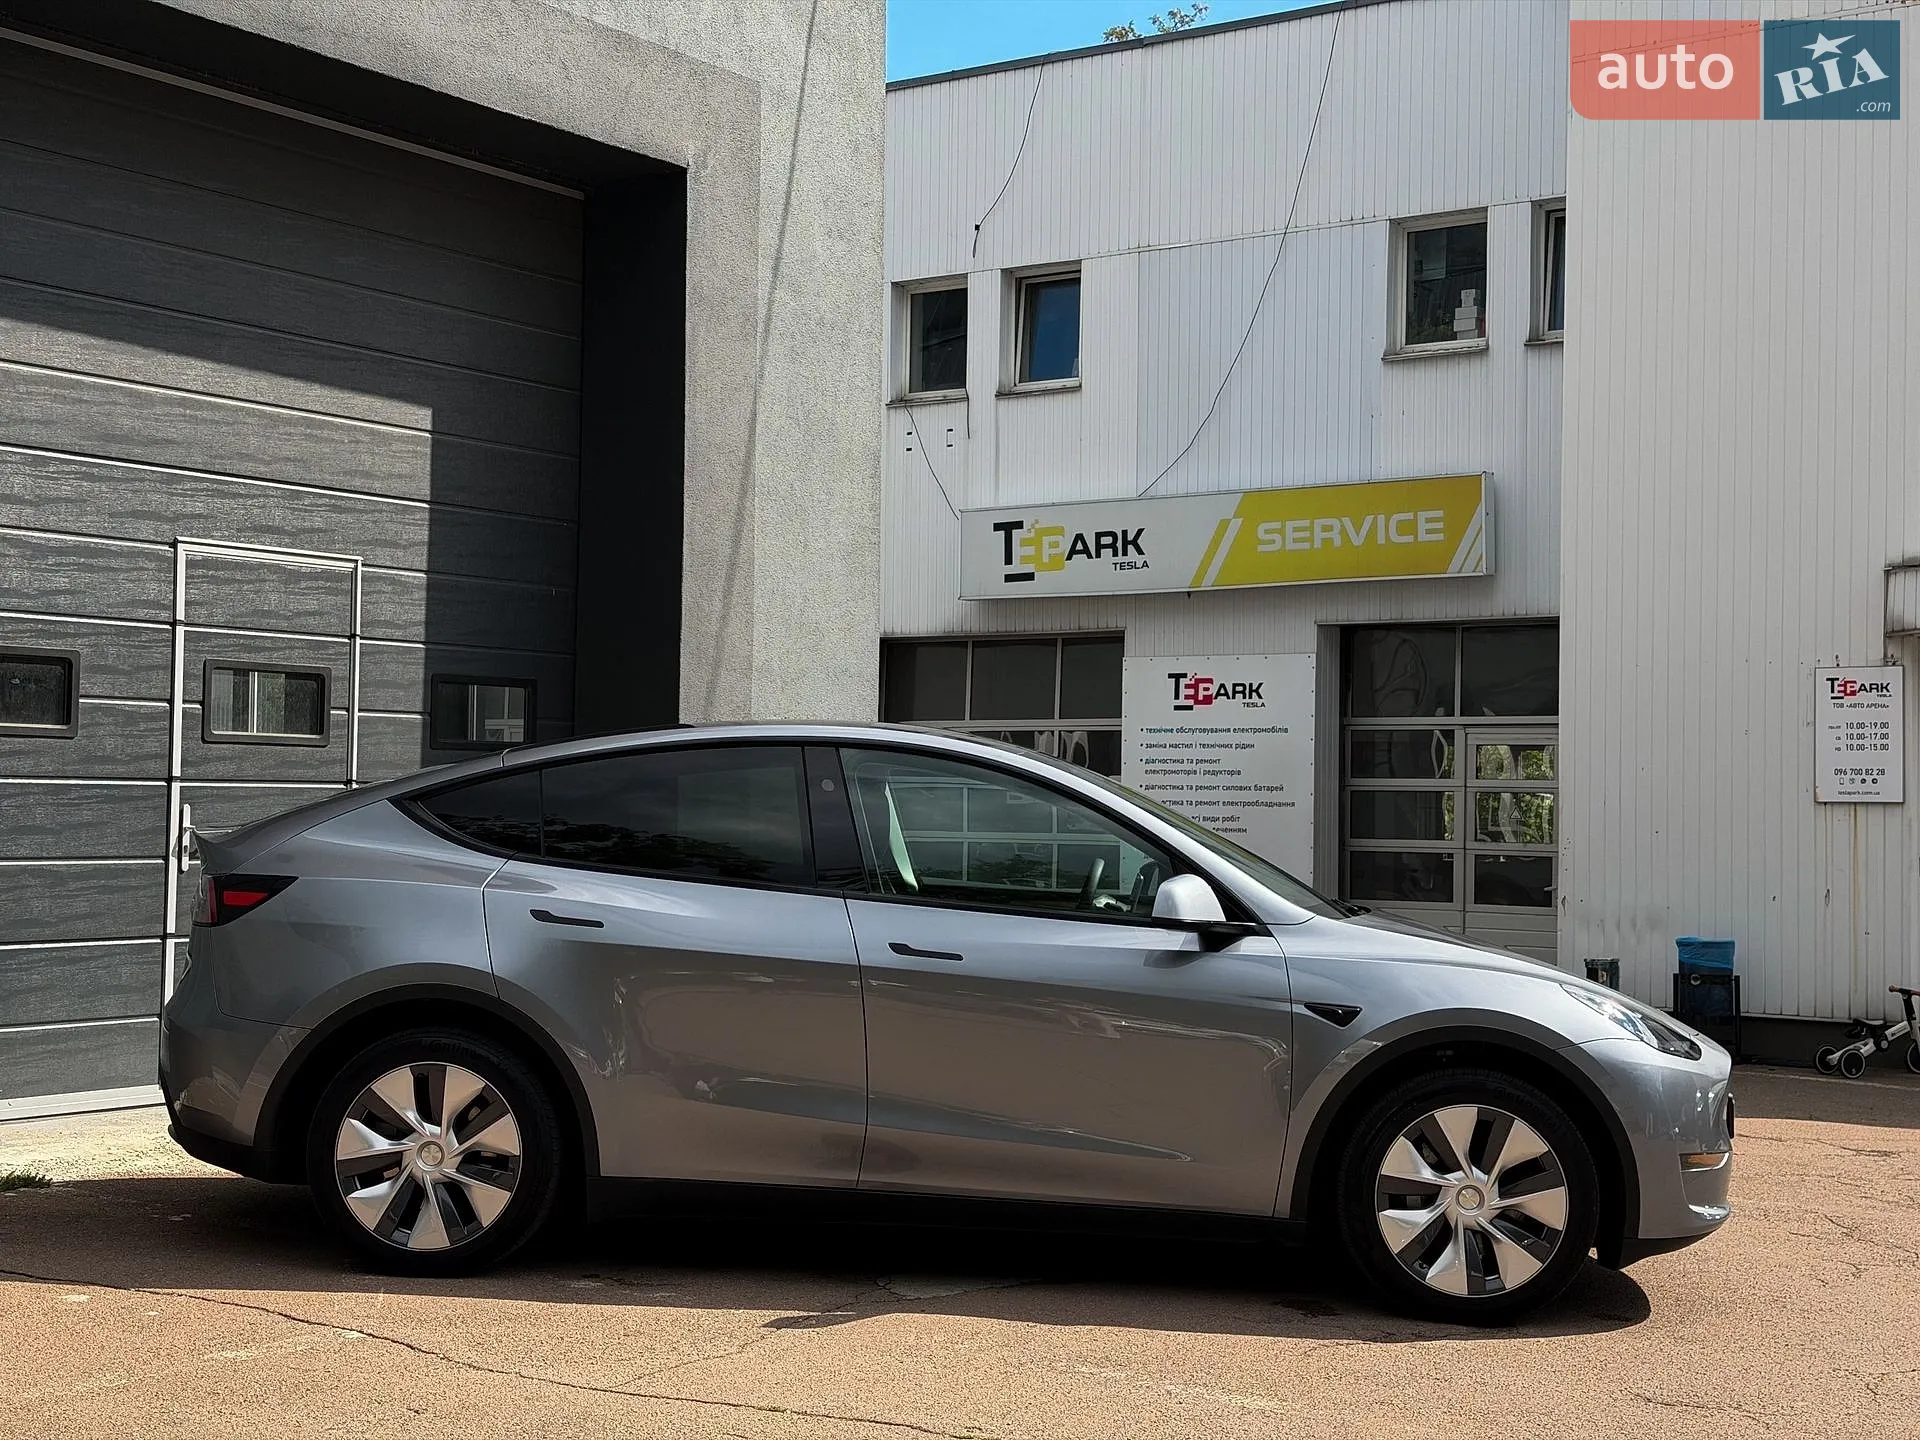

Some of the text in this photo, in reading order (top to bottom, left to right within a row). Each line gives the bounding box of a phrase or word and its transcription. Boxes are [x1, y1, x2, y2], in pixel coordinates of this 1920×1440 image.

[1257, 509, 1445, 553] SERVICE
[1112, 560, 1150, 571] TESLA
[1846, 721, 1889, 730] 10.00-19.00
[1175, 727, 1231, 735] обслуговування
[1232, 726, 1289, 735] електромобілів
[1846, 732, 1889, 741] 10.00-17.00
[1235, 742, 1255, 750] рідин
[1144, 757, 1184, 765] діагностика
[1195, 758, 1221, 766] ремонт
[1144, 768, 1197, 777] електромоторів
[1202, 768, 1242, 777] редукторів
[1834, 768, 1886, 776] 096 700 82 28
[1195, 784, 1220, 792] ремонт
[1253, 784, 1284, 793] батарей
[1195, 800, 1220, 808] ремонт
[1222, 800, 1295, 808] електрообладнання
[1202, 815, 1220, 823] види
[1221, 814, 1240, 824] робіт
